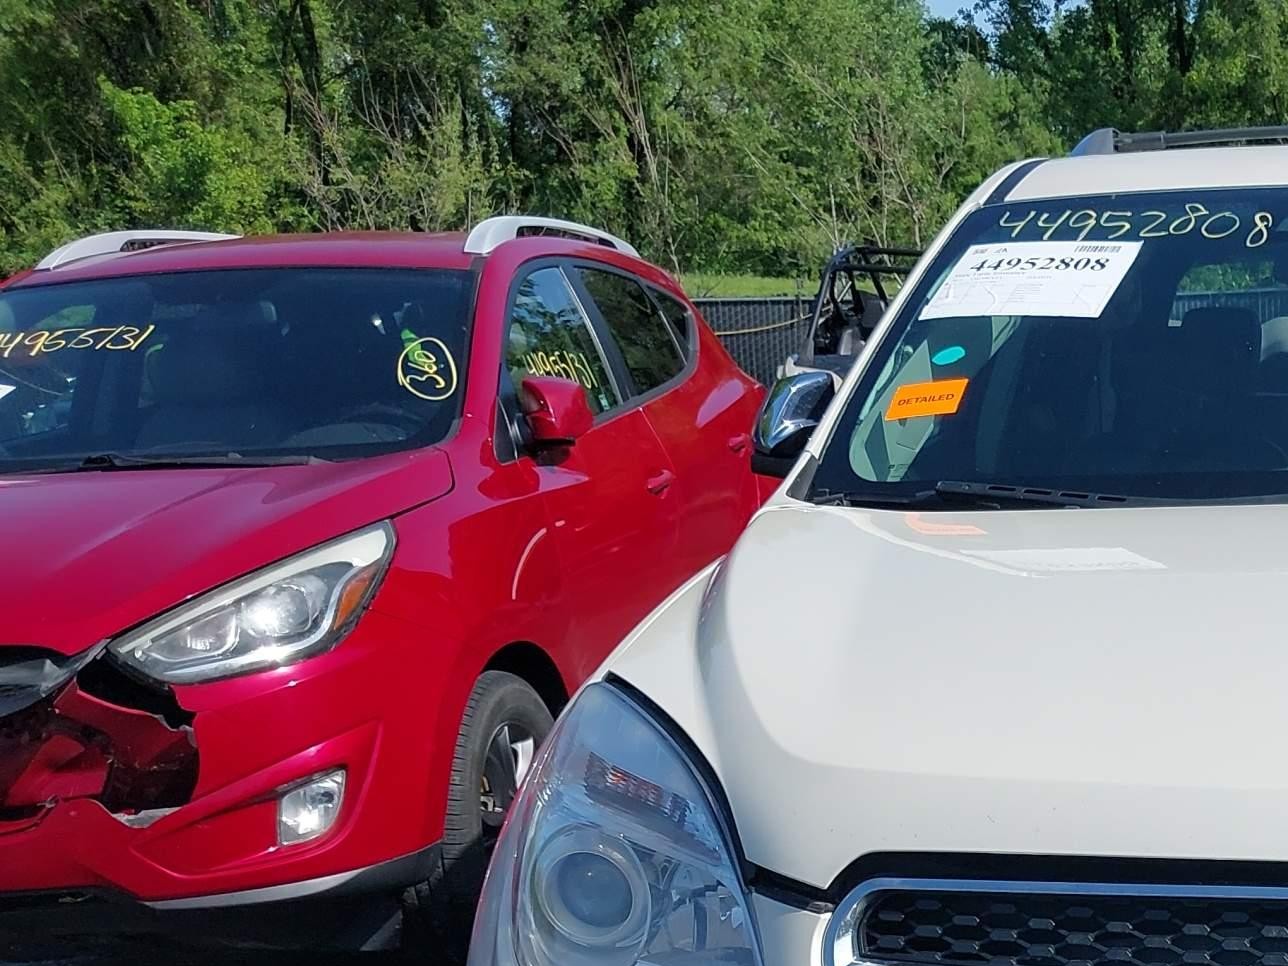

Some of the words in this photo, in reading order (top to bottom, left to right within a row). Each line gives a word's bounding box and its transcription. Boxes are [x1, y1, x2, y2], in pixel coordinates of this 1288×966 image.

[999, 203, 1273, 247] 44952808
[970, 256, 1110, 272] 44952808
[0, 324, 155, 358] 4955131
[897, 392, 955, 406] DETAILED
